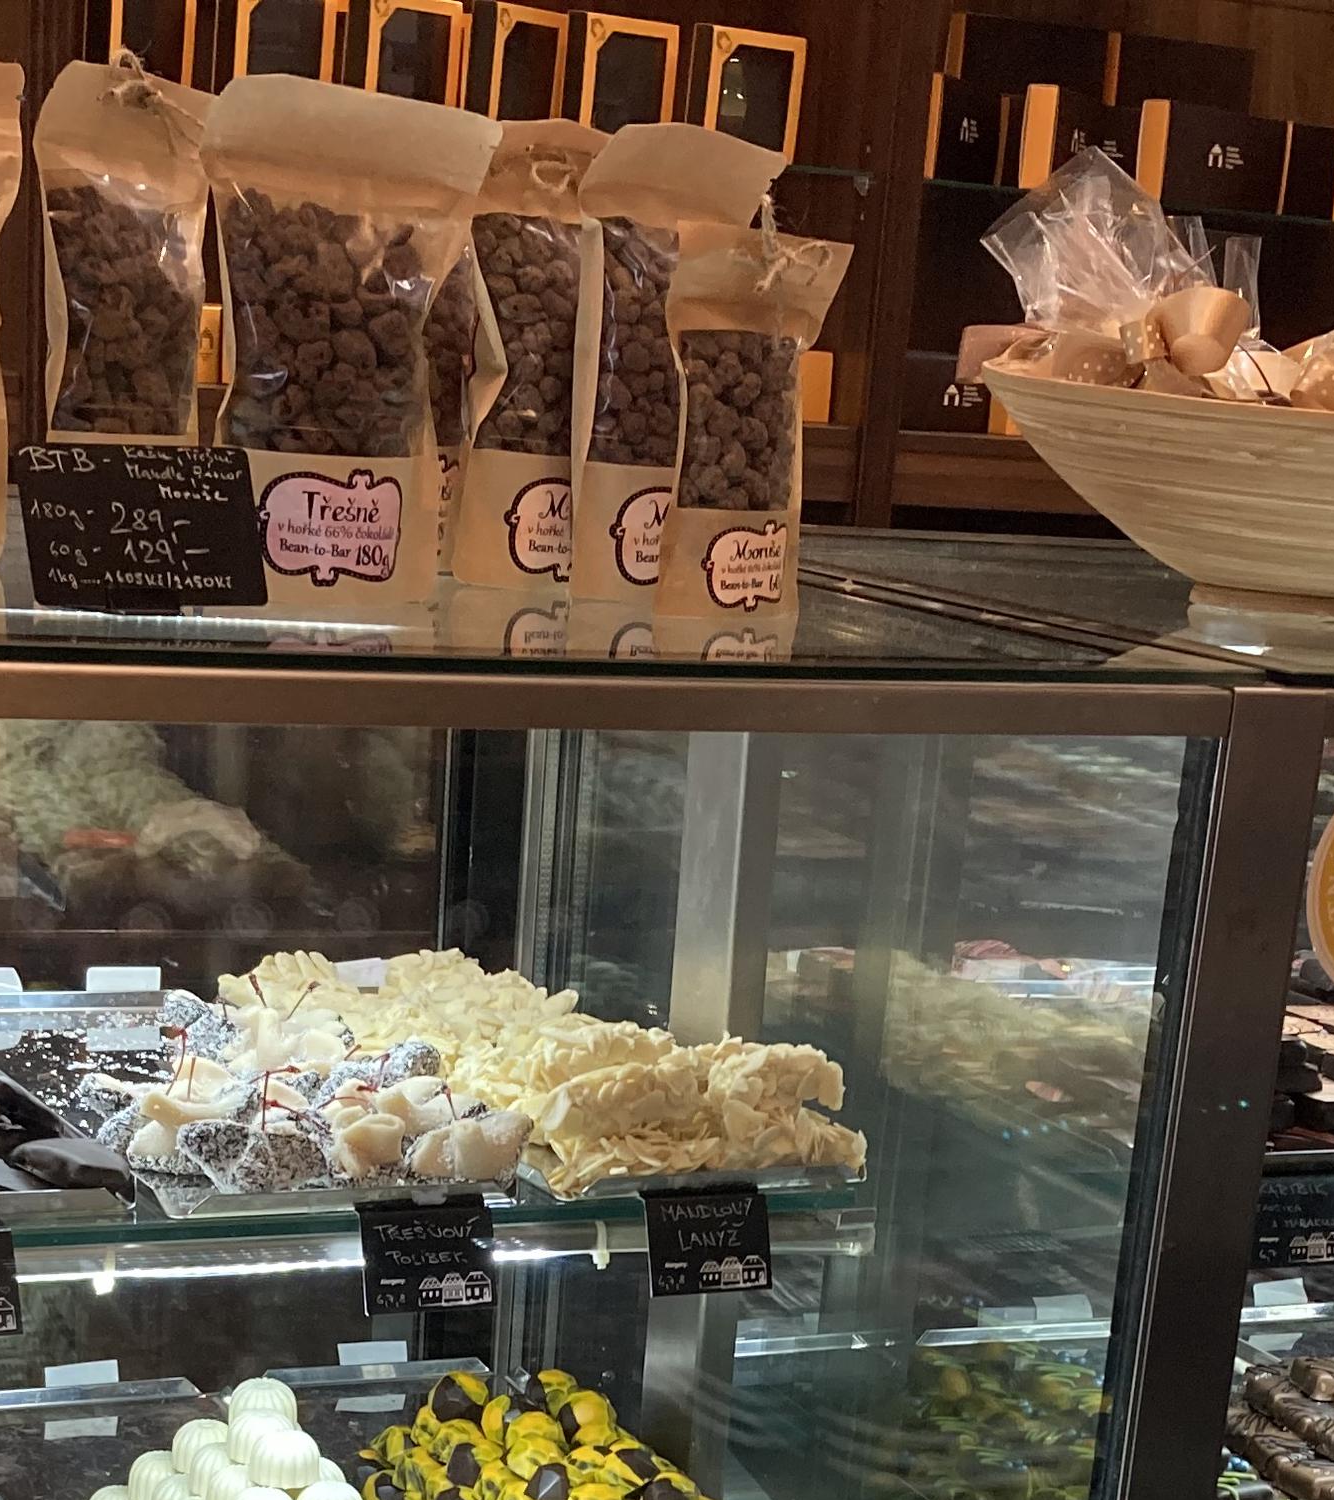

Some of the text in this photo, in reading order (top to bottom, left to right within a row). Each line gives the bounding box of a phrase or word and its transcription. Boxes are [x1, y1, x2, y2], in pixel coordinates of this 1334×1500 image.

[18, 446, 97, 473] BTB
[302, 489, 382, 525] Třešně
[278, 519, 353, 539] v hořké 66%
[528, 527, 534, 536] v
[634, 534, 660, 547] v hoř
[279, 537, 391, 578] Bean-to-Bar 180g
[528, 539, 570, 555] Bean-to-
[660, 1197, 754, 1223] MANDLOVÝ
[677, 1219, 746, 1252] LANÝŽ
